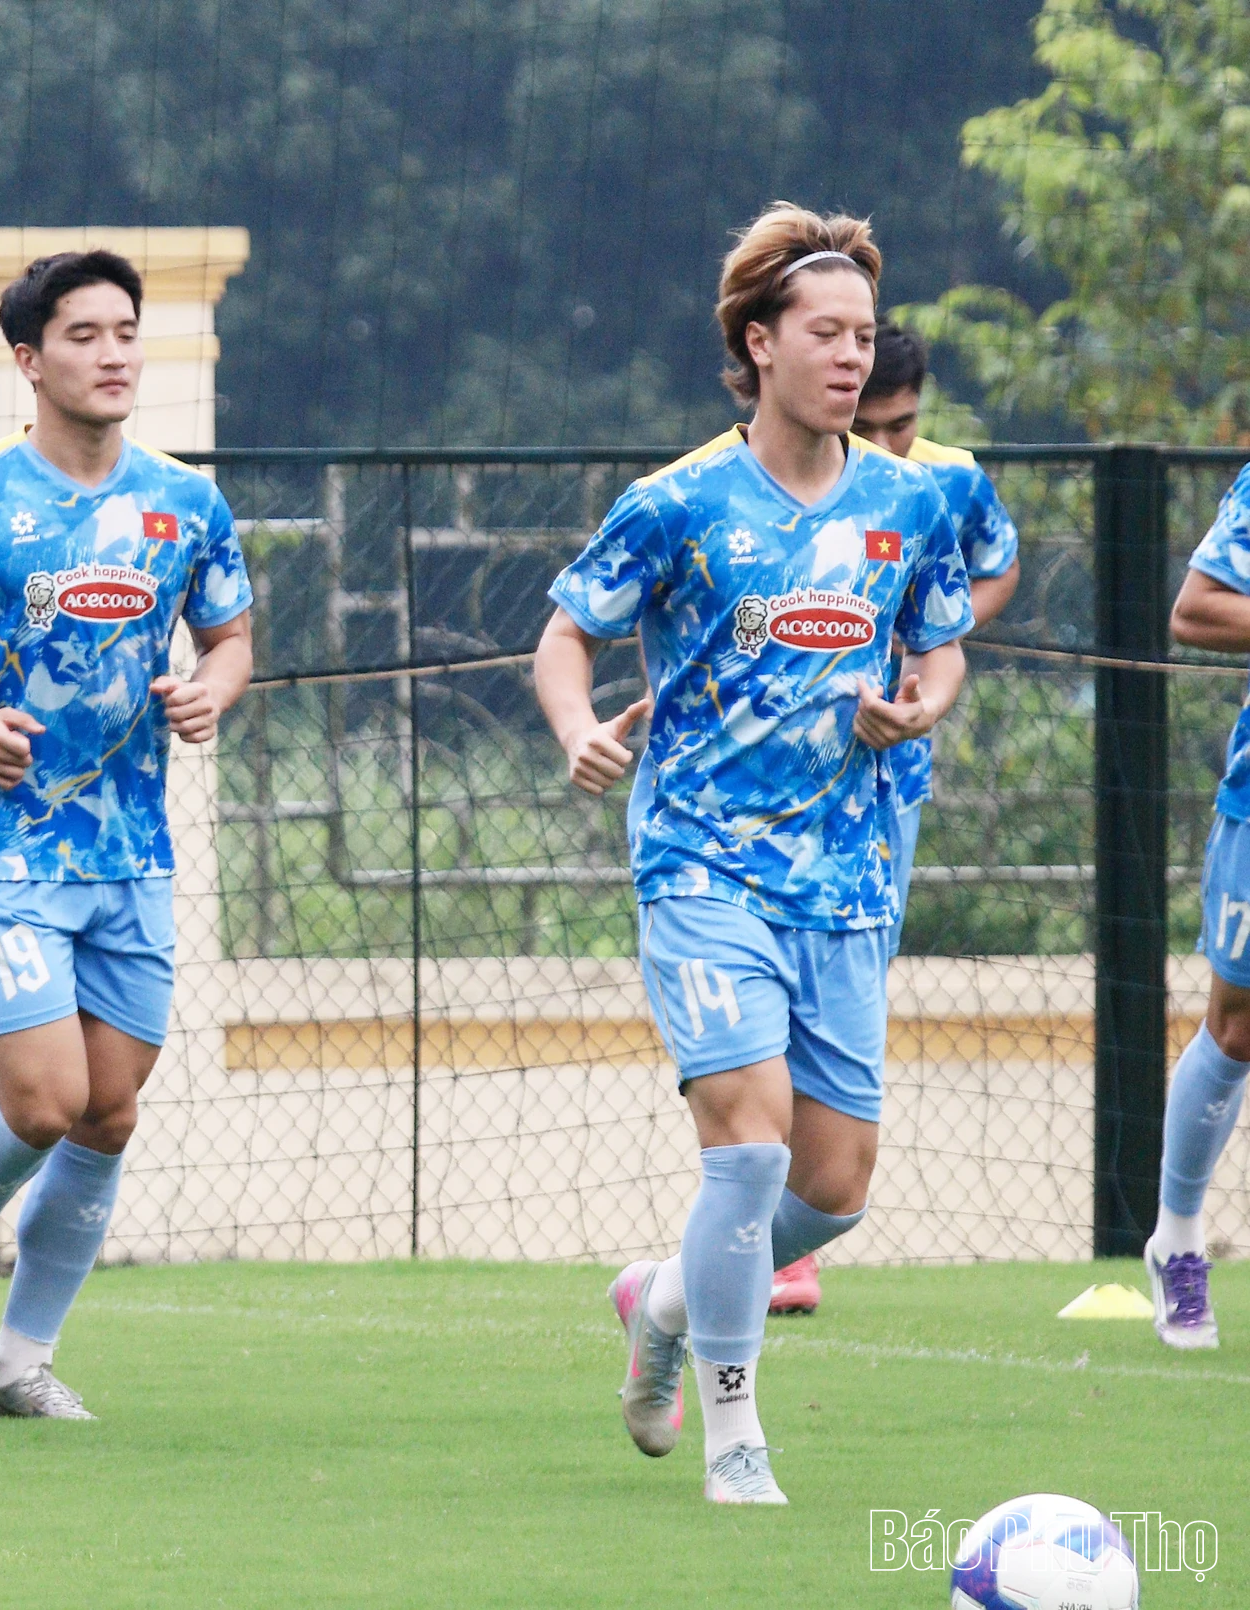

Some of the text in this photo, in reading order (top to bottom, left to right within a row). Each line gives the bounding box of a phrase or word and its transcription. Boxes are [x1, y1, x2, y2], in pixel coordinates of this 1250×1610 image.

[57, 564, 157, 589] Cook happiness
[770, 589, 877, 616] Cook happiness
[1215, 891, 1250, 959] 17
[677, 958, 742, 1040] 14
